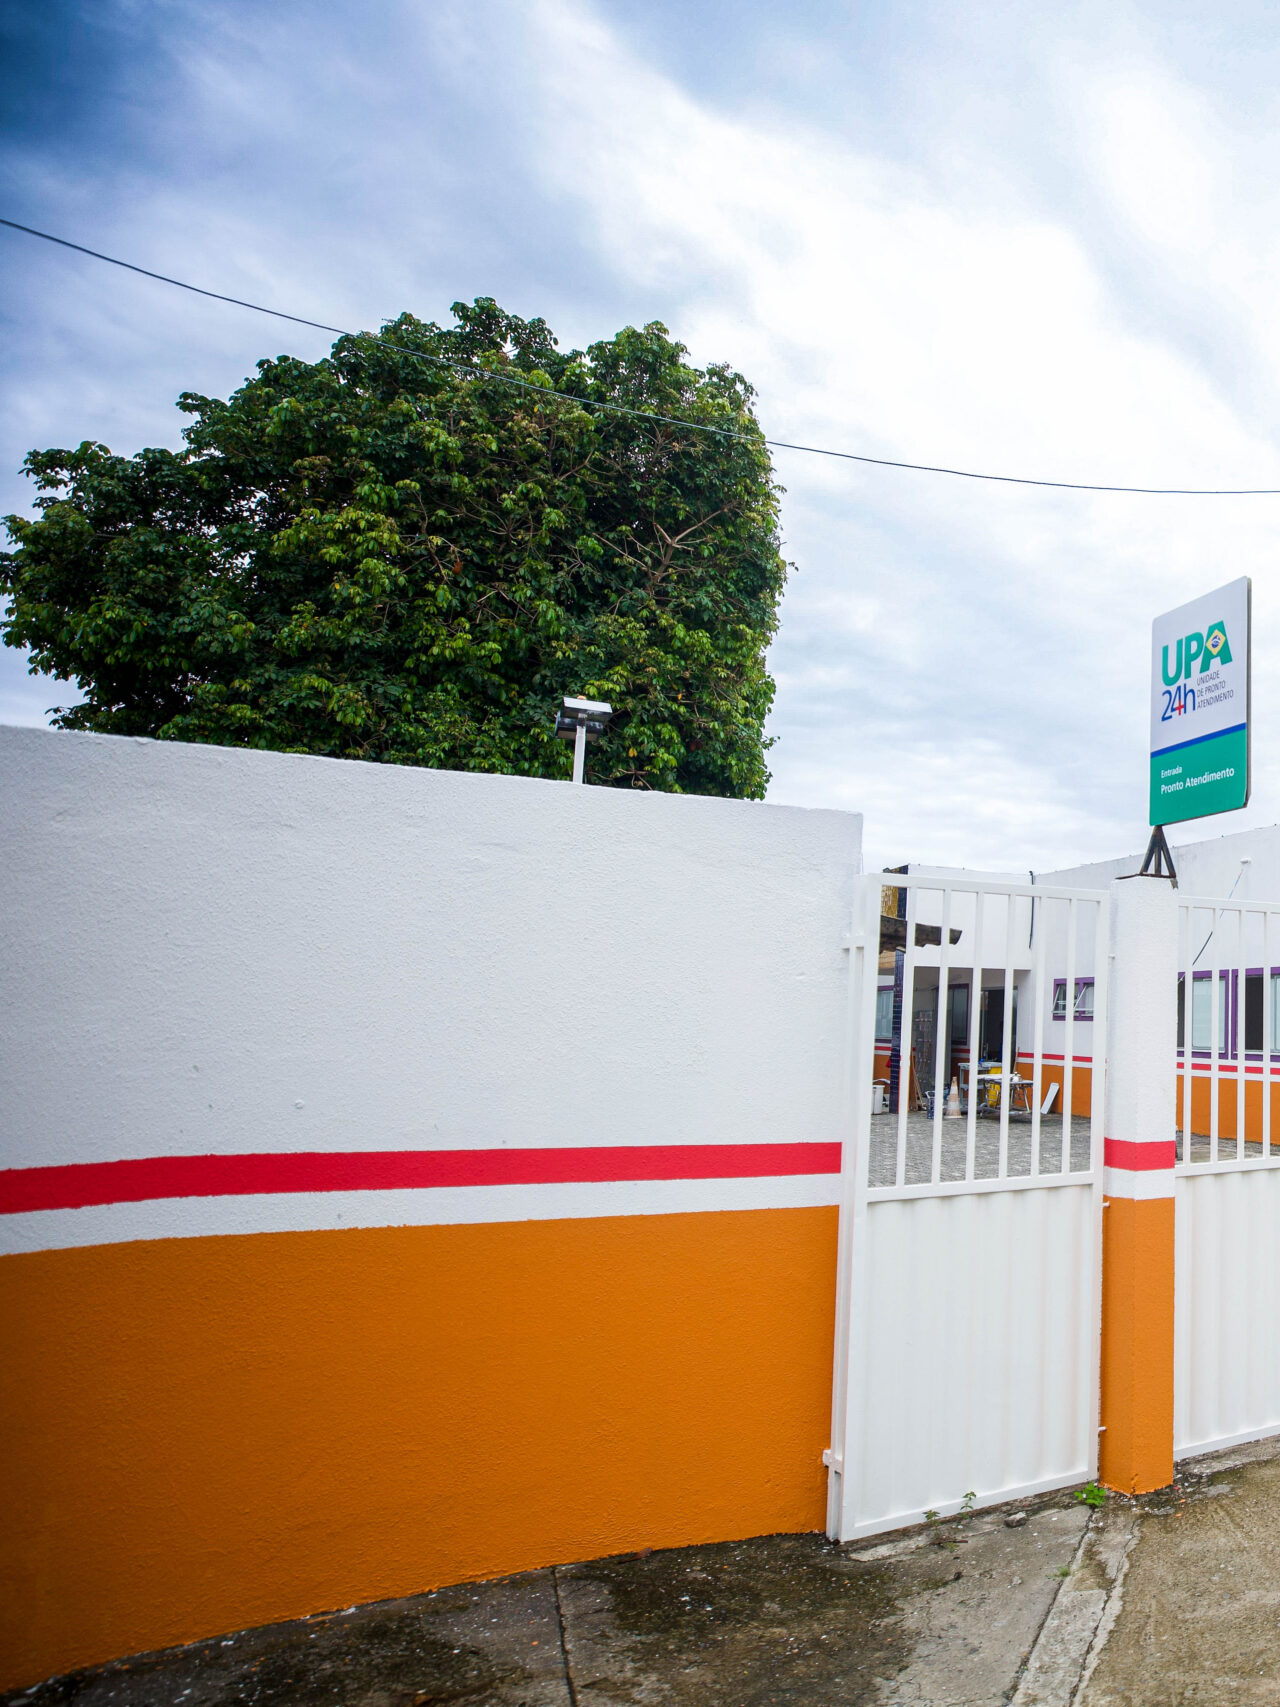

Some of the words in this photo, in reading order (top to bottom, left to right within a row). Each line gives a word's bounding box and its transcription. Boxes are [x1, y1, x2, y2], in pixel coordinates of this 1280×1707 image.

[1161, 620, 1233, 686] UPA
[1196, 670, 1221, 686] UNIDADE
[1196, 689, 1204, 698] DE
[1204, 680, 1226, 695] PRONTO
[1161, 683, 1196, 722] 24h
[1196, 690, 1234, 710] ATENDIMENTO
[1160, 781, 1184, 795] Pronto
[1185, 767, 1235, 789] Atendimento
[1161, 765, 1183, 778] Entrada
